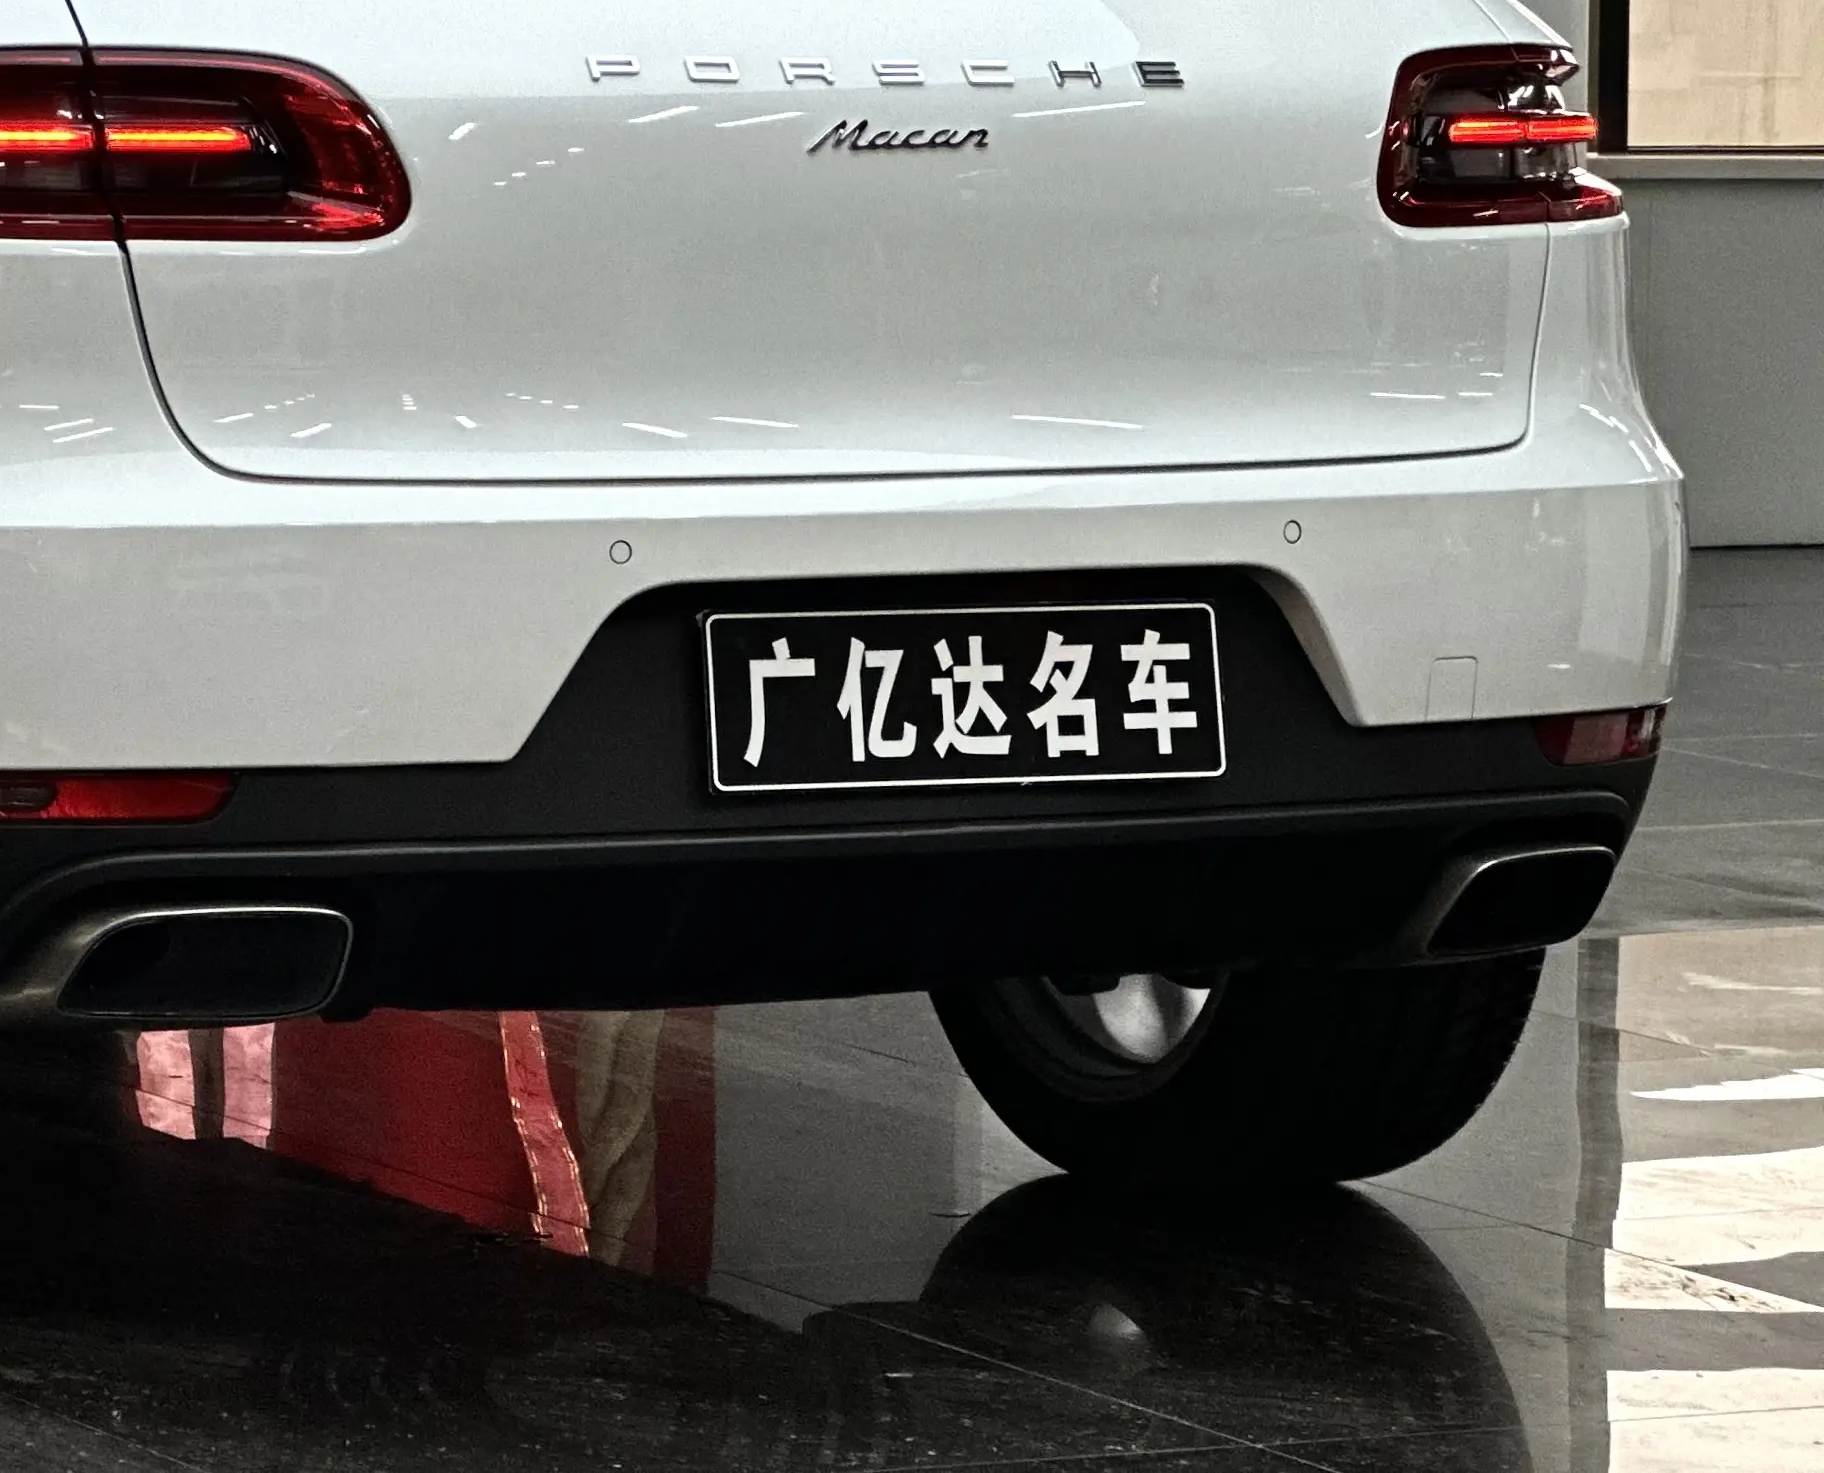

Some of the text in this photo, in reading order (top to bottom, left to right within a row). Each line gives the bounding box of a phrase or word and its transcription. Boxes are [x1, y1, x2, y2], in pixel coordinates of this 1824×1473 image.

[585, 54, 1185, 89] PORSCHE
[806, 118, 991, 155] Macan
[742, 628, 1198, 768] 广亿达名车
